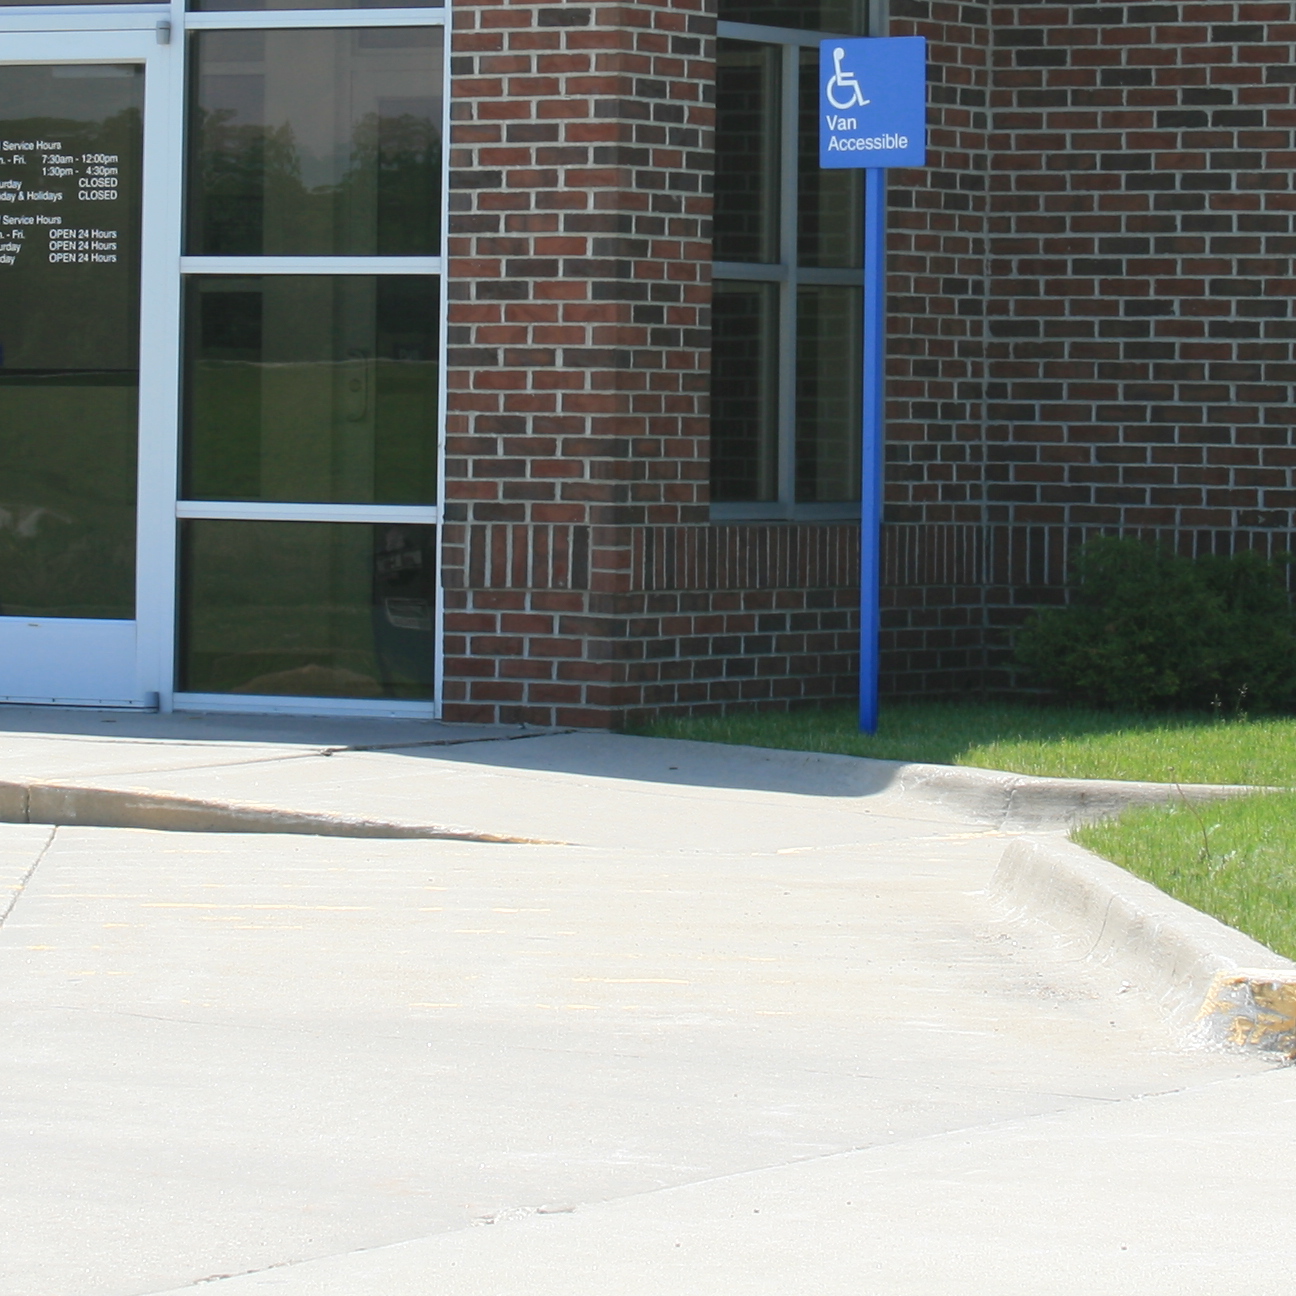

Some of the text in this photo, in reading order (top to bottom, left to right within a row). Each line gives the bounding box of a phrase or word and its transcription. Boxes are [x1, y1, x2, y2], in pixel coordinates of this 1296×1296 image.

[826, 115, 857, 131] Van
[2, 141, 34, 151] Service
[36, 141, 62, 150] Hours
[828, 133, 908, 152] Accessible
[13, 155, 27, 164] Fri.
[42, 154, 74, 164] 7:30am
[82, 154, 118, 165] 12:00pm
[42, 167, 74, 177] 1:30pm
[86, 166, 118, 177] 4:30pm
[78, 177, 118, 188] CLOSED
[18, 191, 24, 201] &
[26, 191, 63, 202] Holidays
[78, 190, 118, 200] CLOSED
[2, 215, 34, 225] Service
[36, 215, 62, 225] Hours
[12, 229, 25, 239] Fri.
[49, 229, 76, 239] OPEN
[78, 229, 89, 238] 24
[91, 229, 117, 238] Hours
[49, 241, 76, 251] OPEN
[78, 241, 89, 250] 24
[91, 241, 117, 250] Hours
[49, 253, 76, 263] OPEN
[78, 253, 89, 262] 24
[91, 253, 117, 262] Hours
